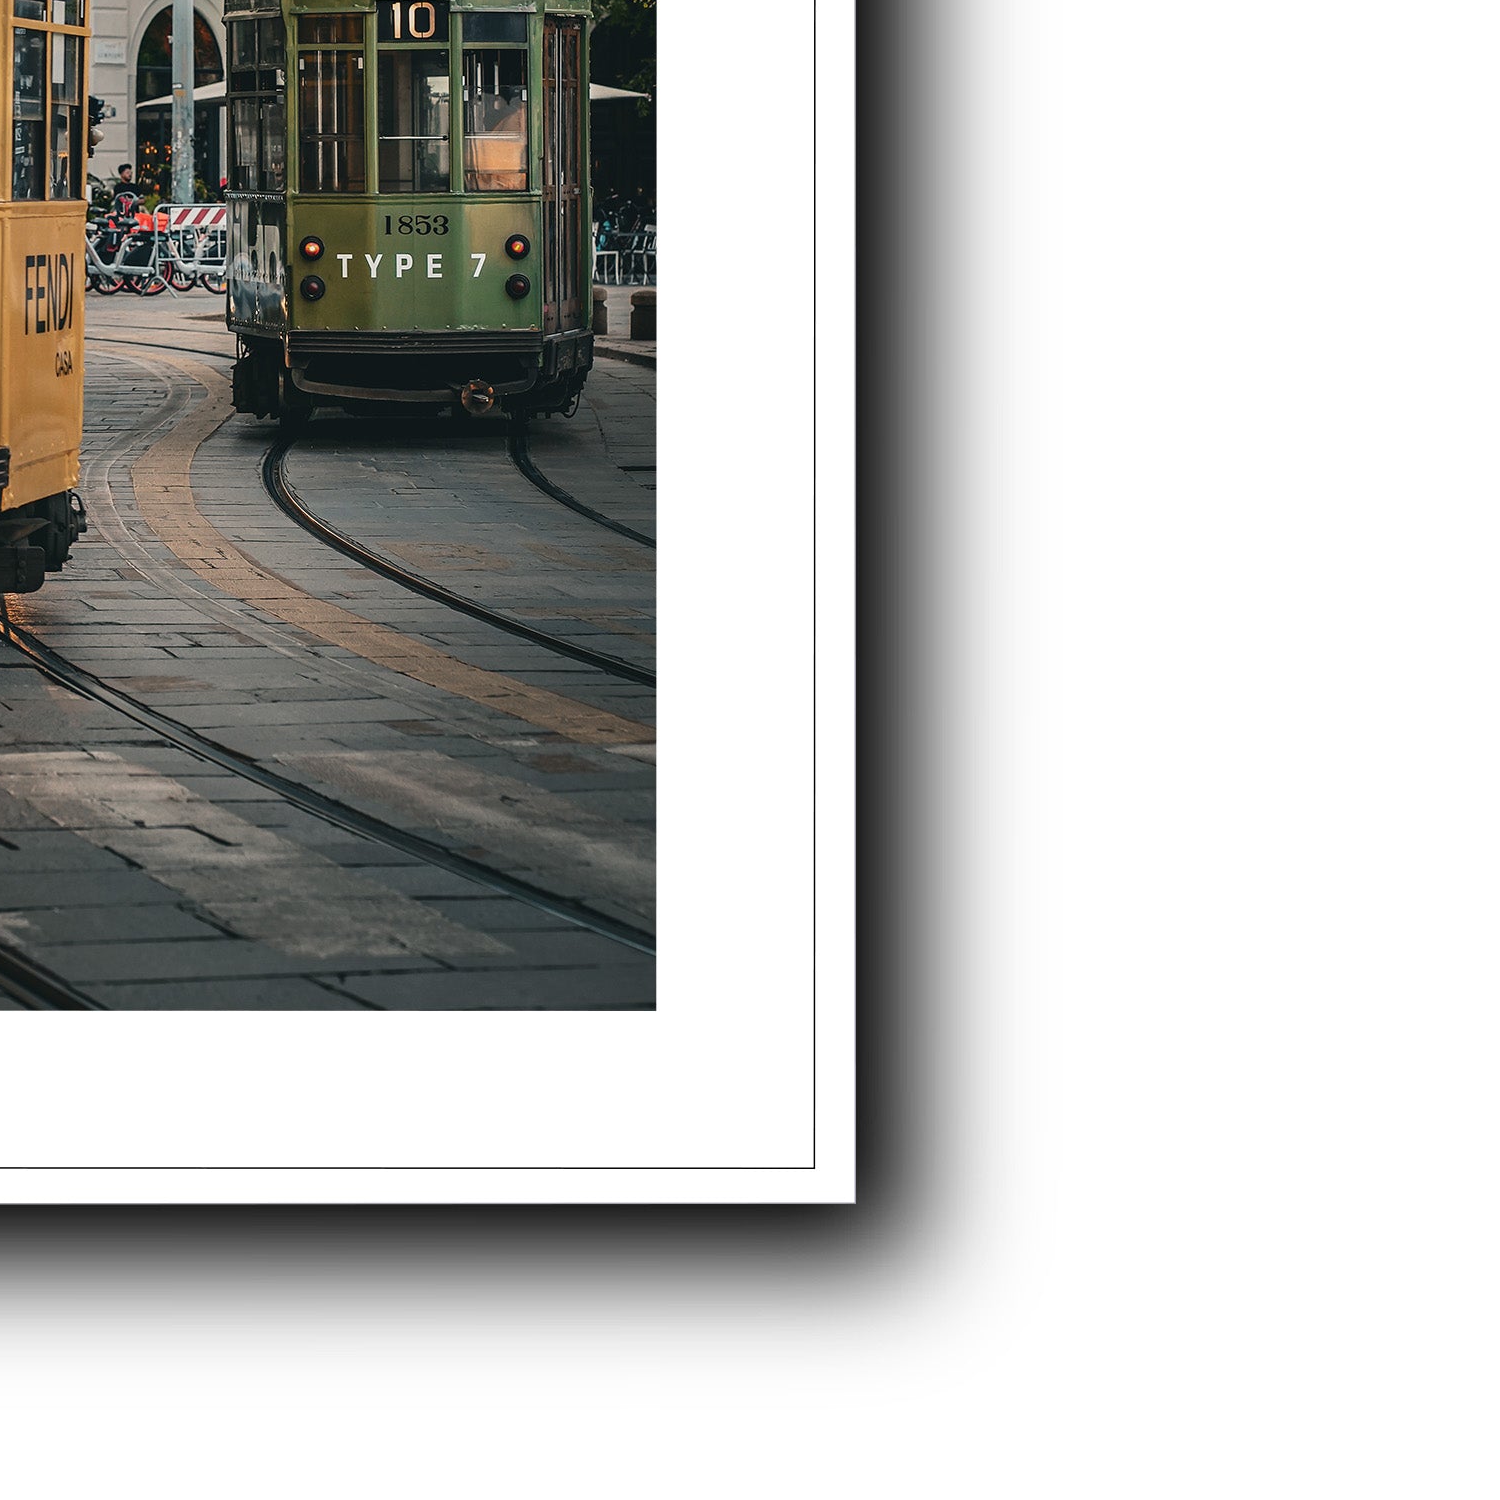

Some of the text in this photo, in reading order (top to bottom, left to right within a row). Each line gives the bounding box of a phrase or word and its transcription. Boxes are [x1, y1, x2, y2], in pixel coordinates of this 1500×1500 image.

[391, 2, 436, 40] 10
[384, 215, 450, 236] 1853
[336, 253, 487, 278] TYPE 7
[25, 252, 74, 335] FENDI
[55, 350, 73, 377] CASA
